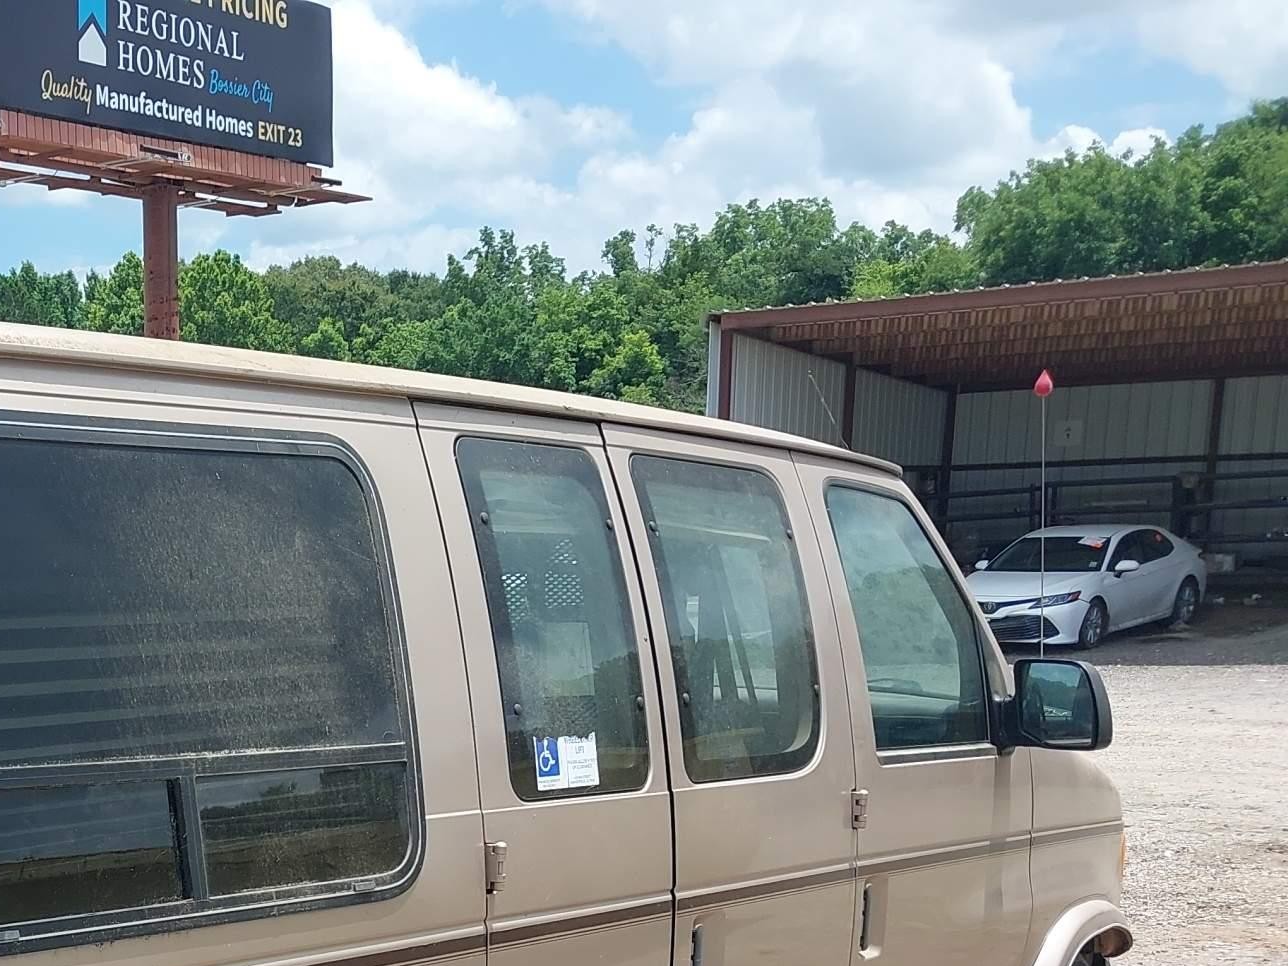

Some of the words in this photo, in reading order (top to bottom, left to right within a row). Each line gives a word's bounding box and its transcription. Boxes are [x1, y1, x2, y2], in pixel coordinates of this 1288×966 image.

[117, 0, 245, 61] REGIONAL
[41, 70, 92, 115] Quality
[96, 84, 202, 128] Manufactured
[206, 110, 253, 138] Homes
[258, 121, 285, 145] EXIT
[288, 129, 302, 147] 23
[117, 40, 205, 89] HOMES
[209, 69, 250, 98] Bossier
[251, 79, 273, 112] City
